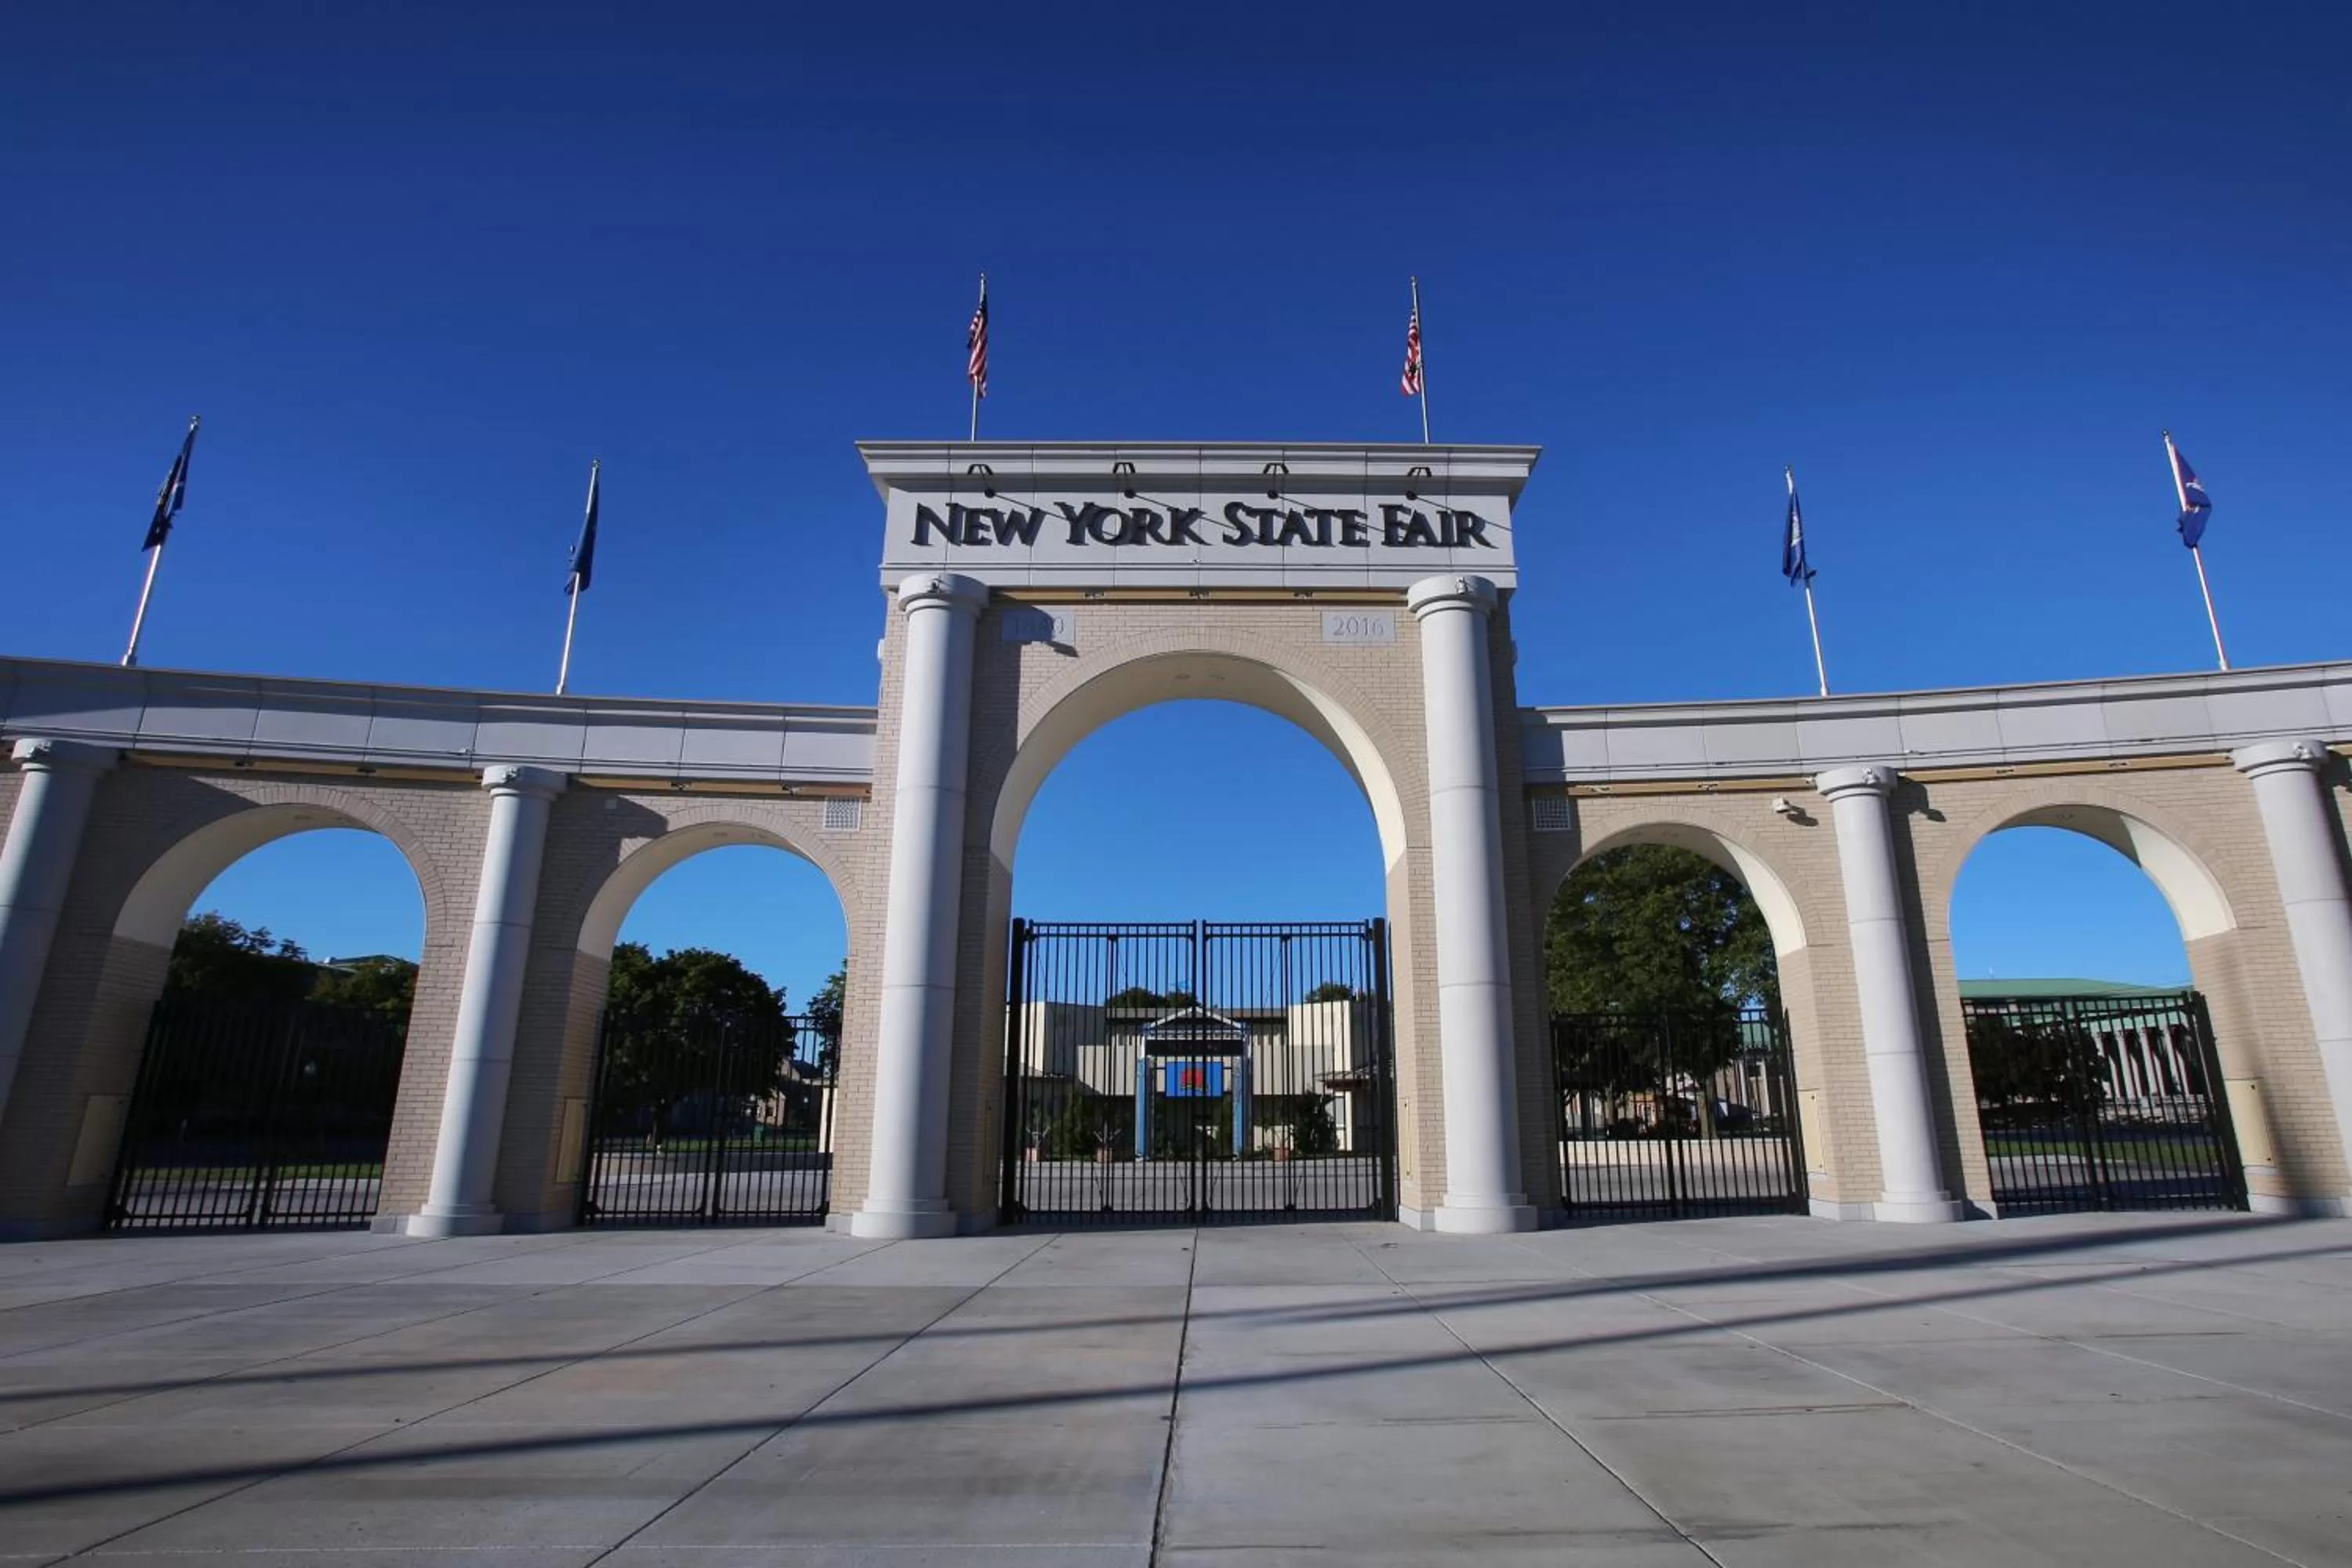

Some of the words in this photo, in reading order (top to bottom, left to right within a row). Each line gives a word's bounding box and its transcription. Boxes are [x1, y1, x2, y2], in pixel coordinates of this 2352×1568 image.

[910, 502, 1047, 546] NEW
[1053, 501, 1213, 546] YORK
[1222, 501, 1370, 546] STATE
[1377, 503, 1499, 549] FAIR
[1332, 615, 1385, 637] 2016
